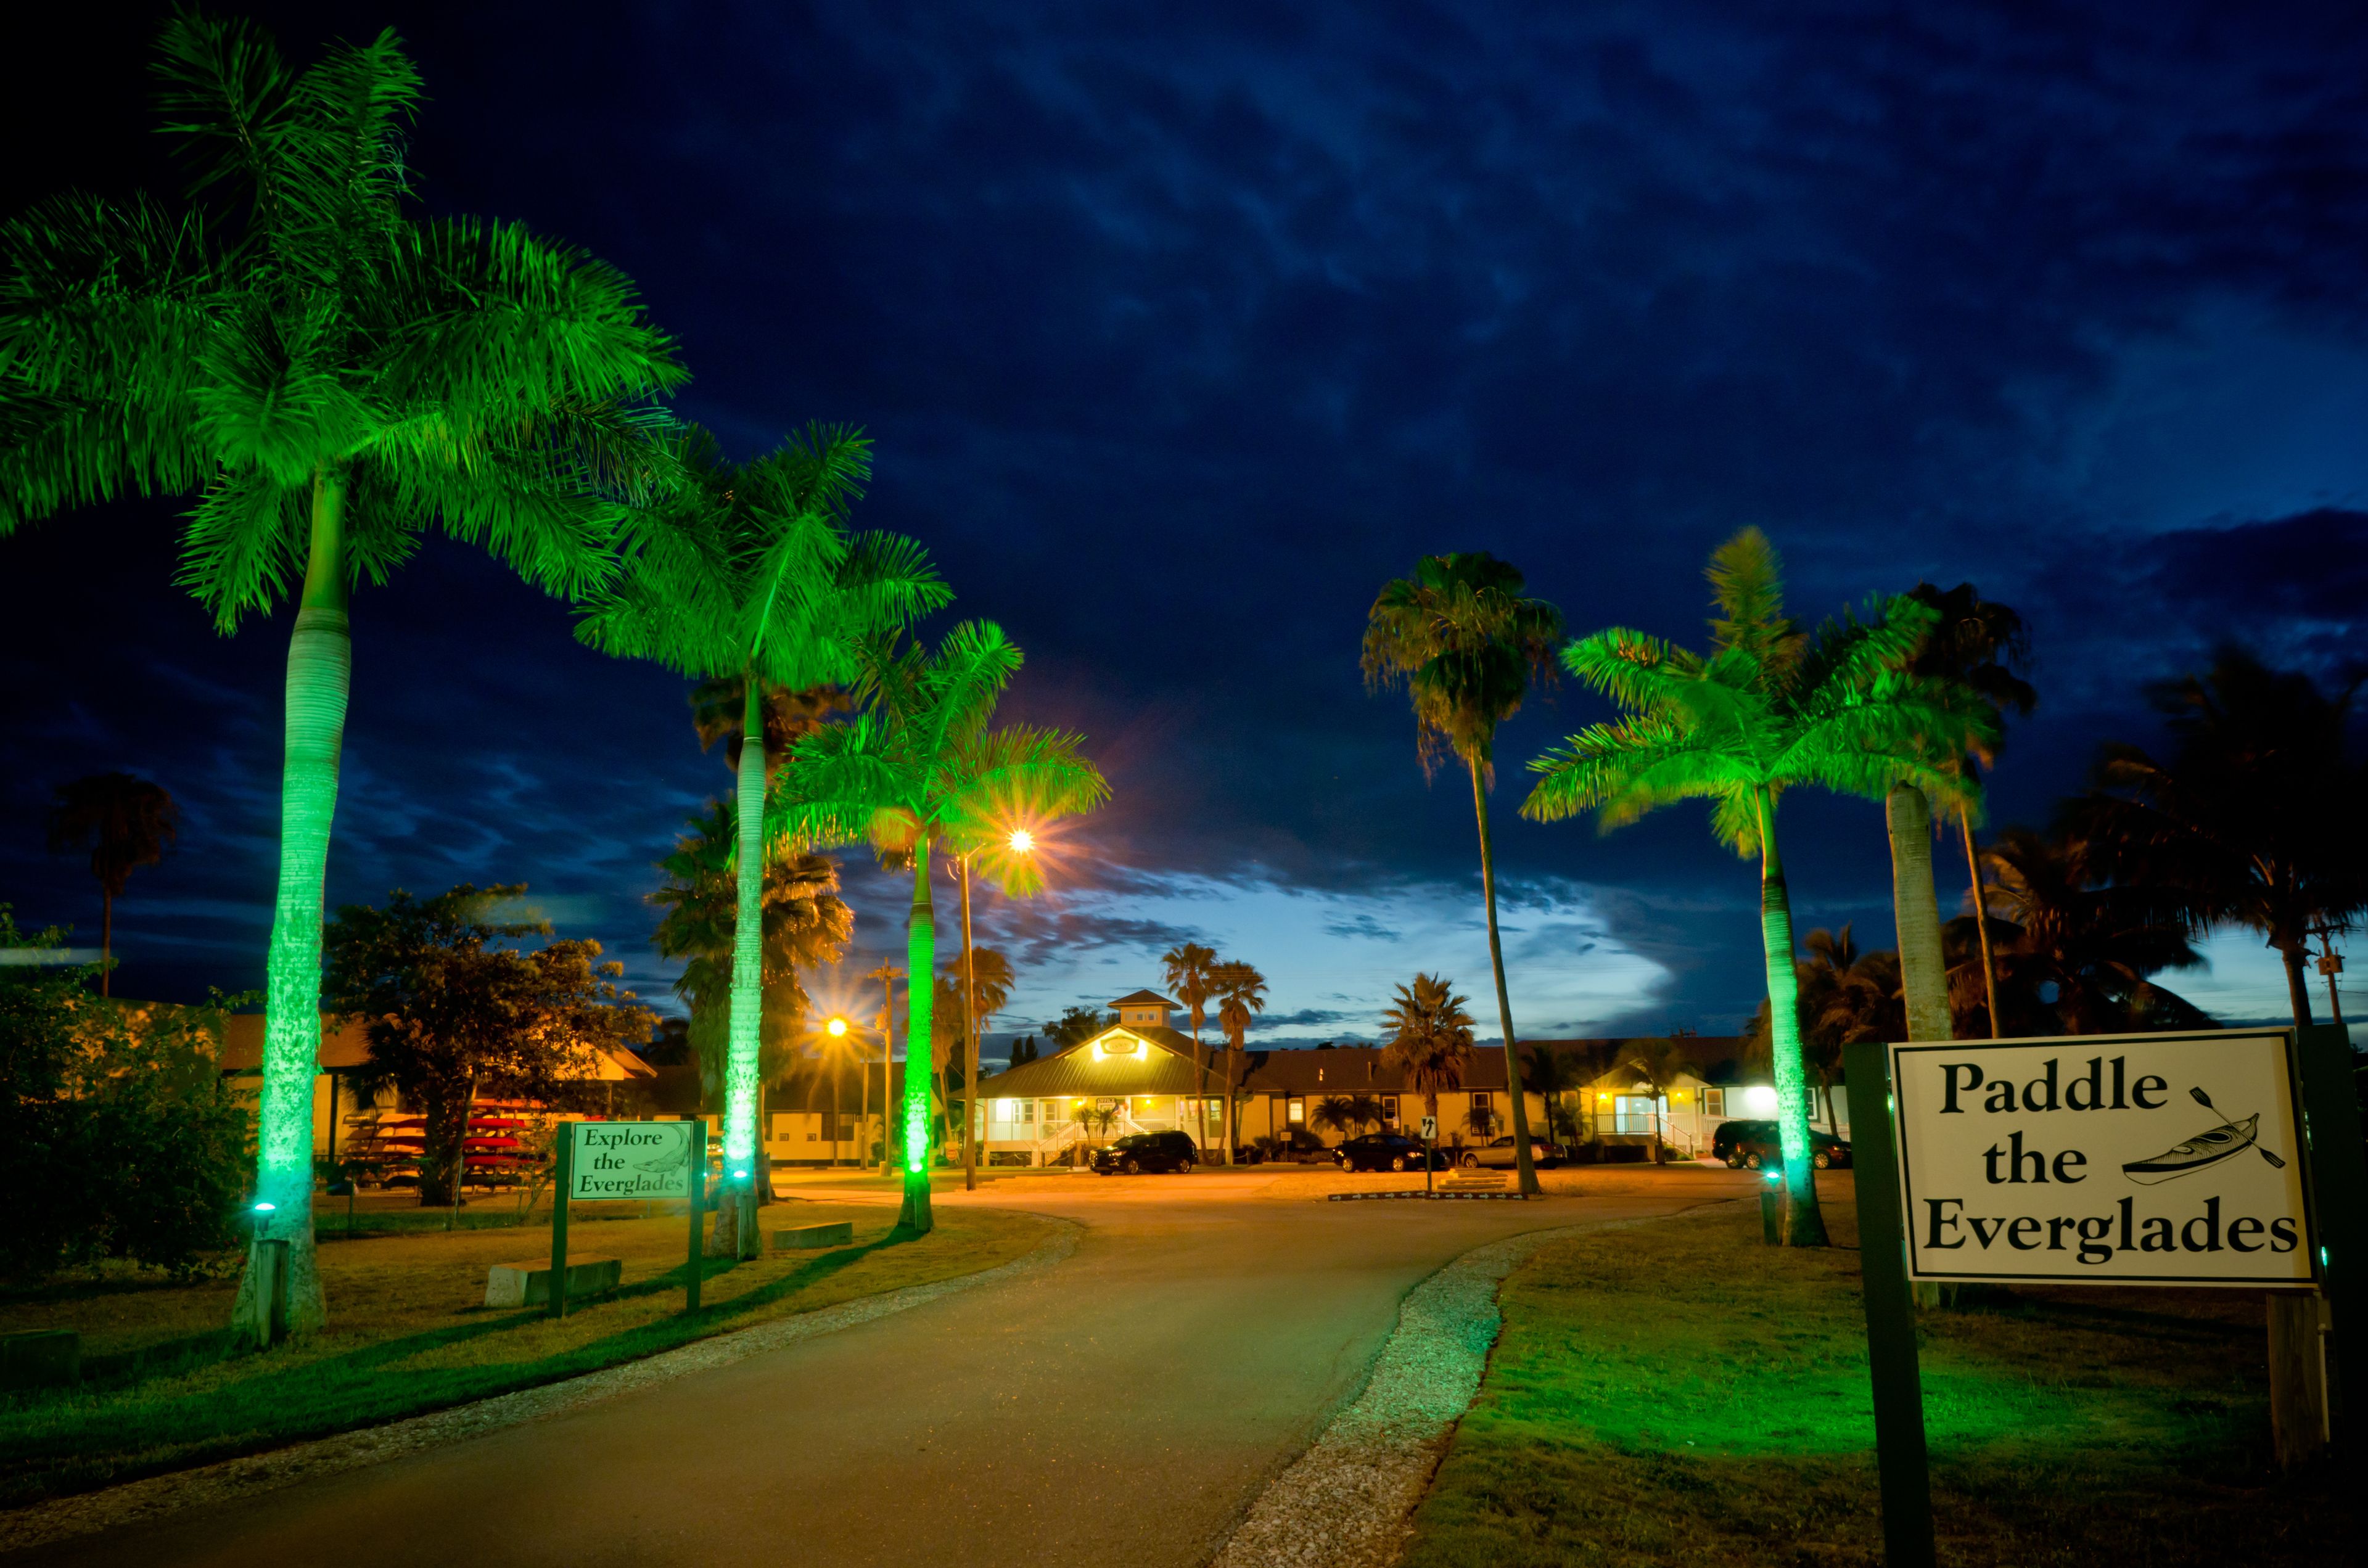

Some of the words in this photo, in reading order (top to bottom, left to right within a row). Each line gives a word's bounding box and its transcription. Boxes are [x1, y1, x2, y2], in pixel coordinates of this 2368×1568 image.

[1938, 1055, 2168, 1114] Paddle
[583, 1128, 662, 1150] Explore
[1981, 1130, 2088, 1185] the
[593, 1152, 625, 1170] the
[579, 1173, 683, 1196] Everglades
[1922, 1196, 2299, 1265] Everglades
